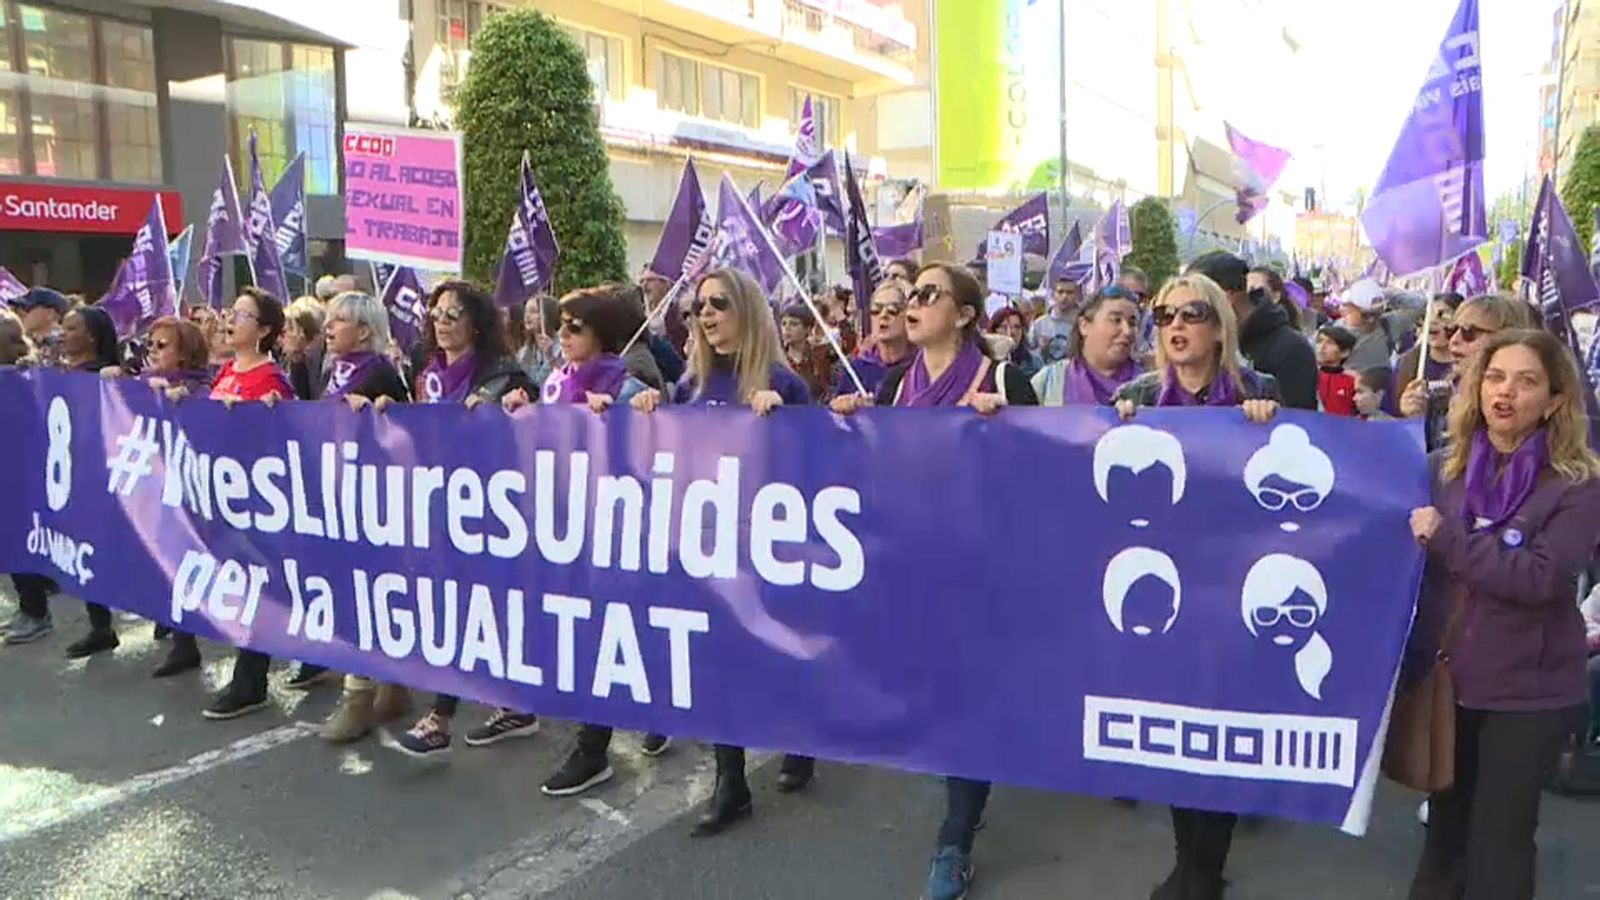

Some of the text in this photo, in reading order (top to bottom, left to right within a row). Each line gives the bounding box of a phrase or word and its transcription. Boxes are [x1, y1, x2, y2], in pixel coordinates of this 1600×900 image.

[345, 135, 393, 156] CCOO
[346, 160, 366, 178] O
[369, 163, 397, 183] AL
[6, 195, 119, 220] Santander
[346, 190, 454, 217] EXUAL EN
[46, 396, 72, 511] 8
[171, 550, 709, 709] per la IGUALTAT
[1098, 710, 1264, 765] CCOO
